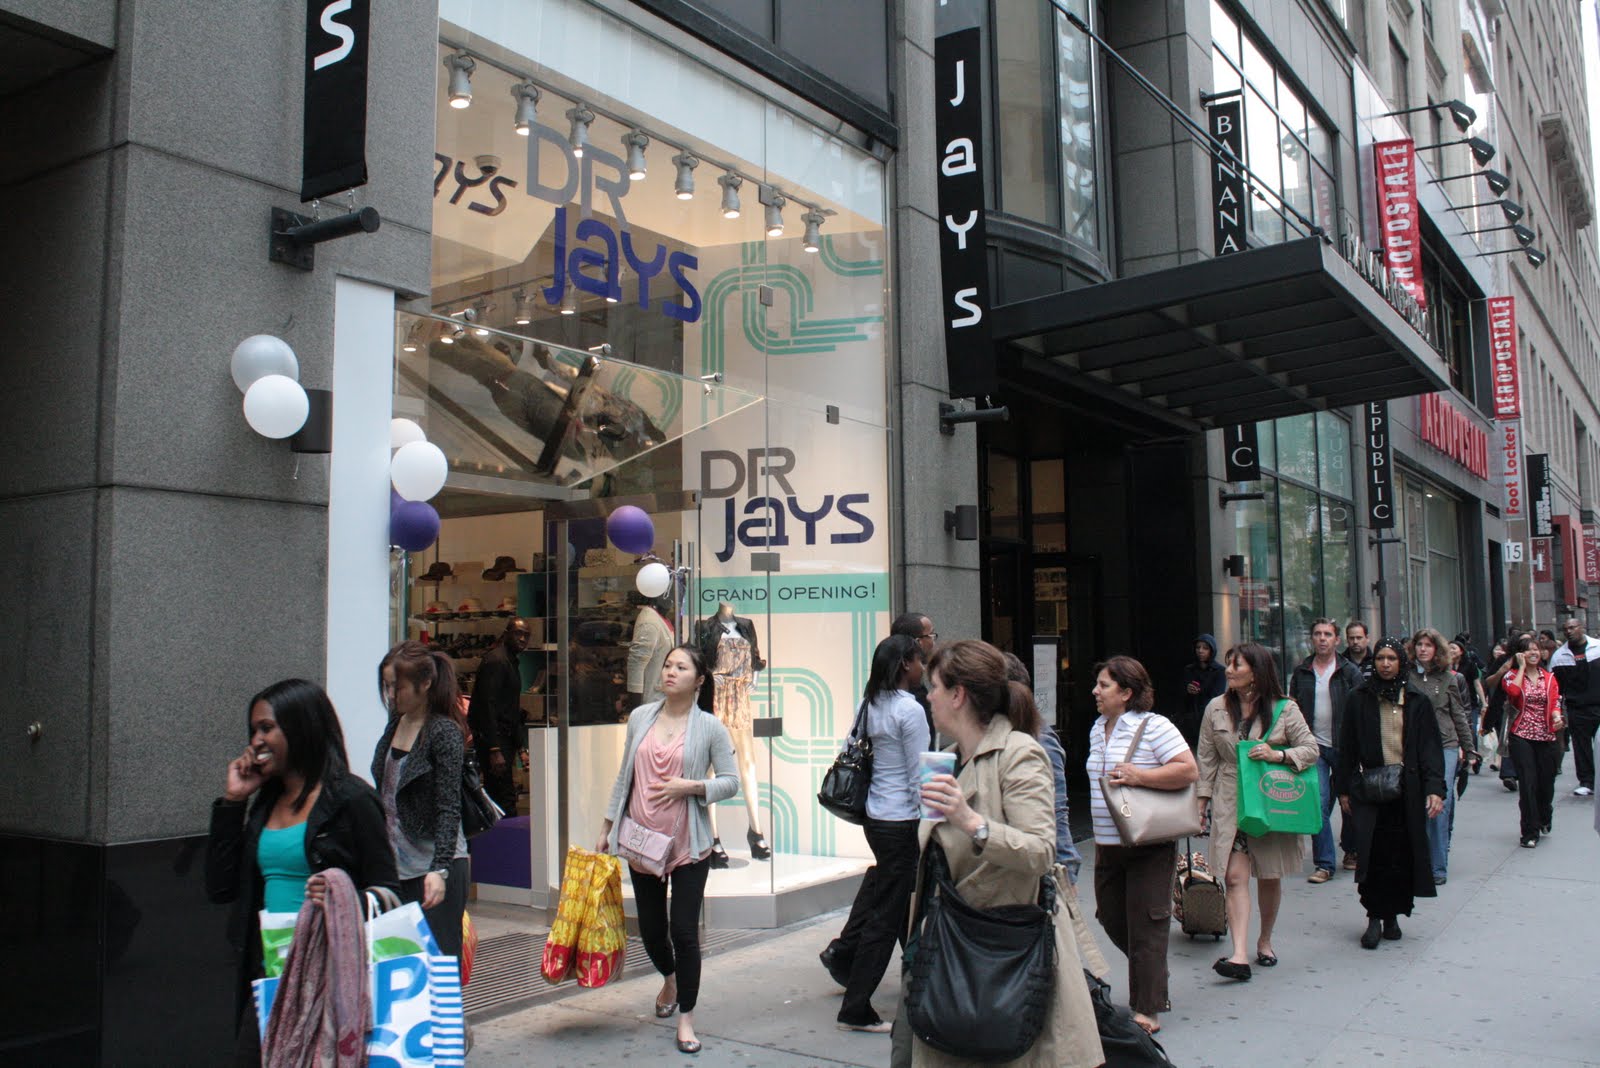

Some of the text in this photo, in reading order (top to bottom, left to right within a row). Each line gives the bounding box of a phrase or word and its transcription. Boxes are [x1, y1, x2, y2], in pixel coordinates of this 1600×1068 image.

[527, 120, 630, 233] DR
[1216, 115, 1240, 254] BANANA
[1383, 144, 1416, 300] EROPOSTALE
[1492, 300, 1516, 414] AEROPOSTALE
[701, 447, 796, 499] DR
[1371, 401, 1390, 519] EPUBLIC
[1503, 426, 1520, 515] Foot Locker
[702, 582, 876, 603] GRAND OPENING!
[1506, 545, 1521, 560] 15
[1586, 548, 1597, 578] WEST
